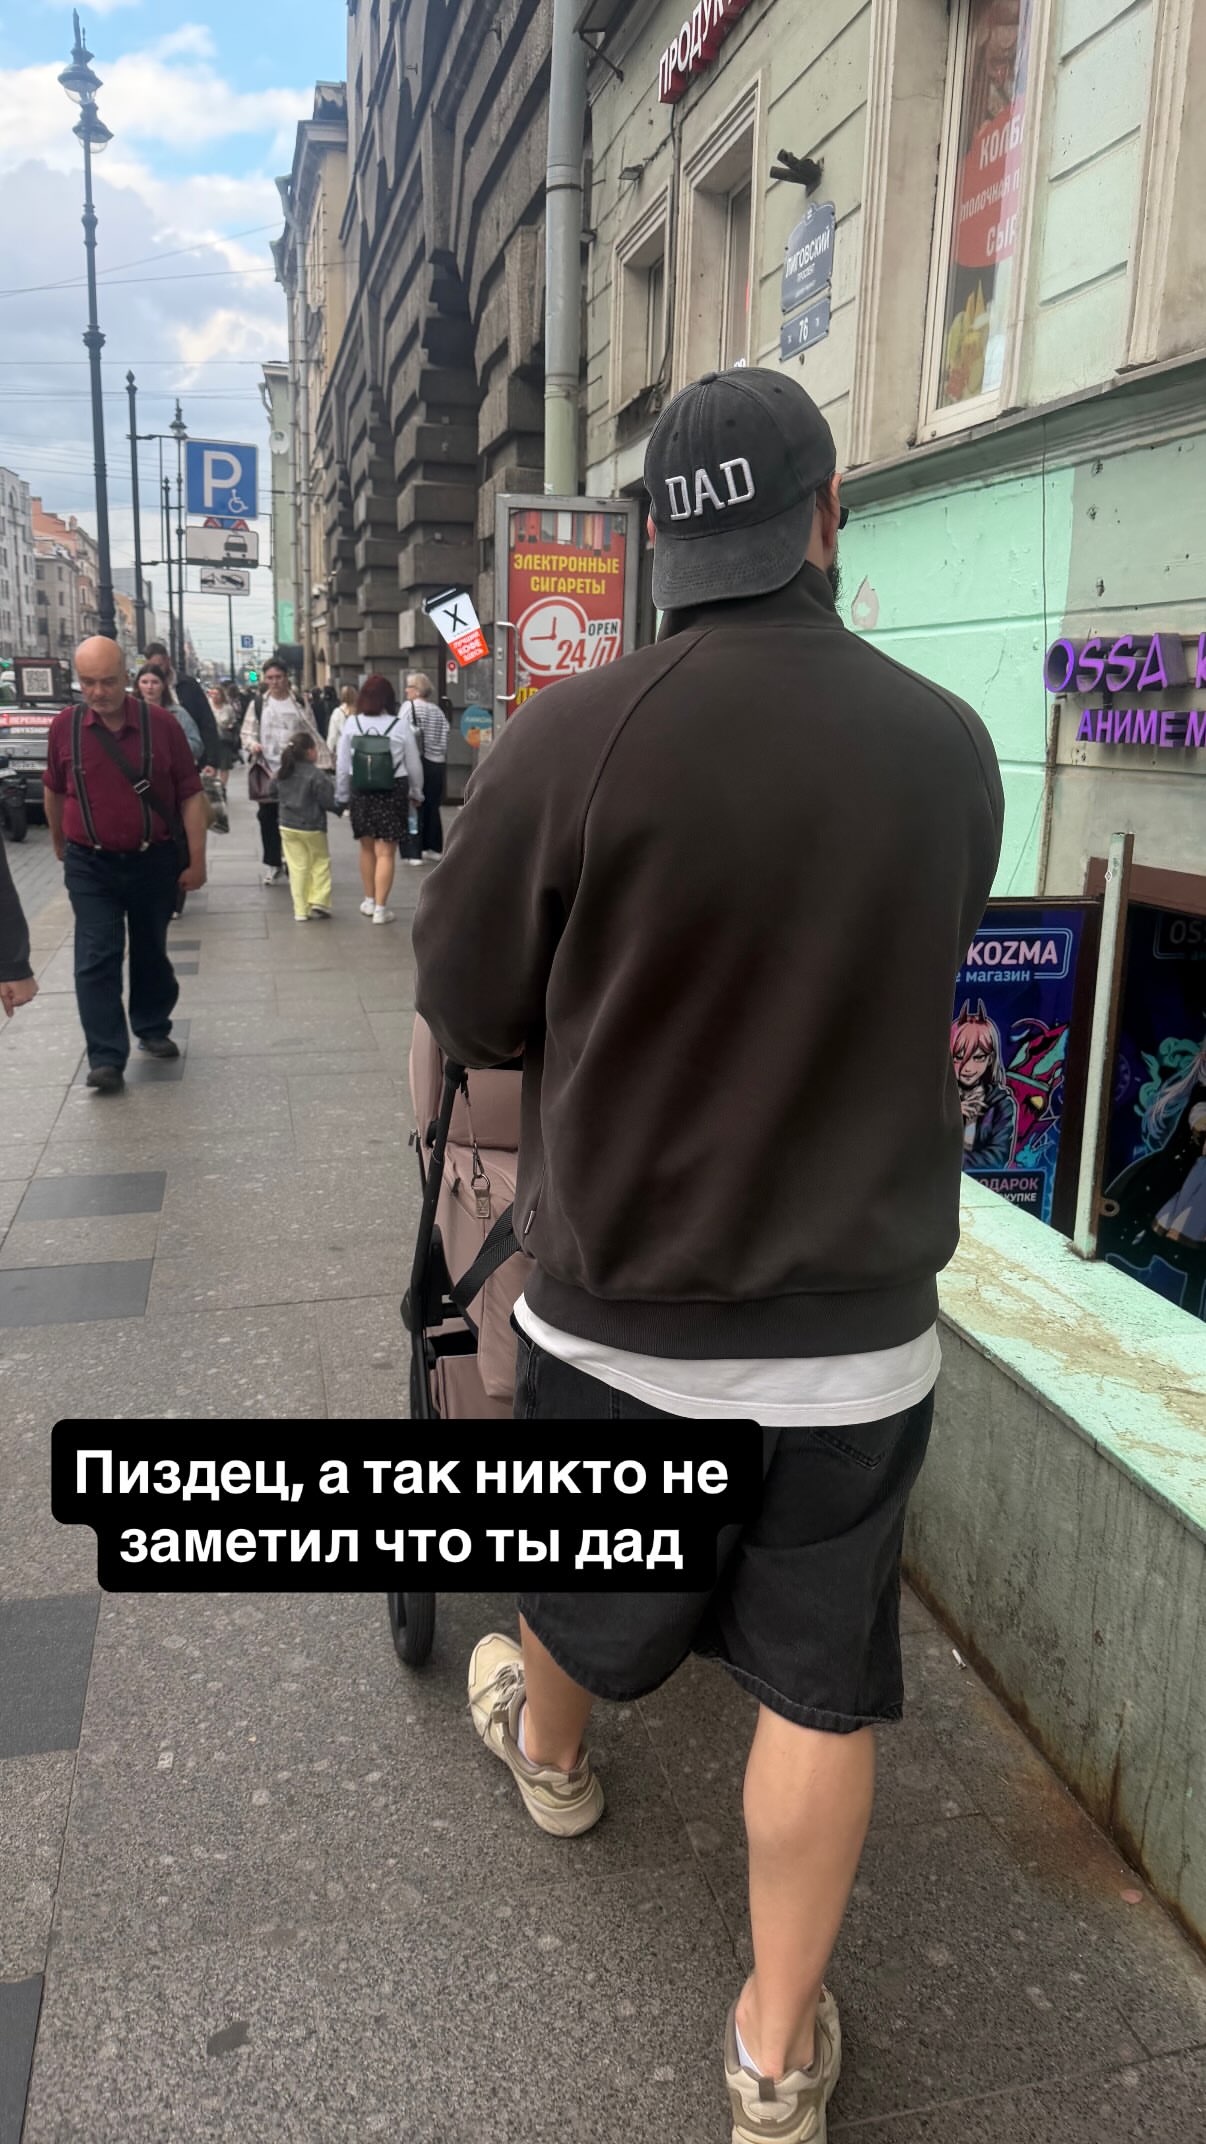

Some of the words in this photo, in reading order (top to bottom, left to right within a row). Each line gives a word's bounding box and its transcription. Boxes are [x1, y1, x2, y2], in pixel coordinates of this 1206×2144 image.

[658, 0, 732, 102] ПРОДУК
[785, 227, 831, 278] ЛИГОВСКИЙ
[799, 316, 809, 343] 76
[665, 457, 756, 521] DAD
[514, 553, 620, 574] ЭЛЕКТРОННЫЕ
[530, 576, 606, 595] СИГАРЕТЫ
[588, 621, 619, 637] OPEN
[555, 636, 618, 671] 24/7
[1043, 632, 1168, 693] OSSA
[1075, 708, 1176, 748] АНИМЕ
[966, 940, 1058, 966] KOZMA
[966, 970, 1031, 983] магазин
[979, 1178, 1039, 1192] ОДАРОК
